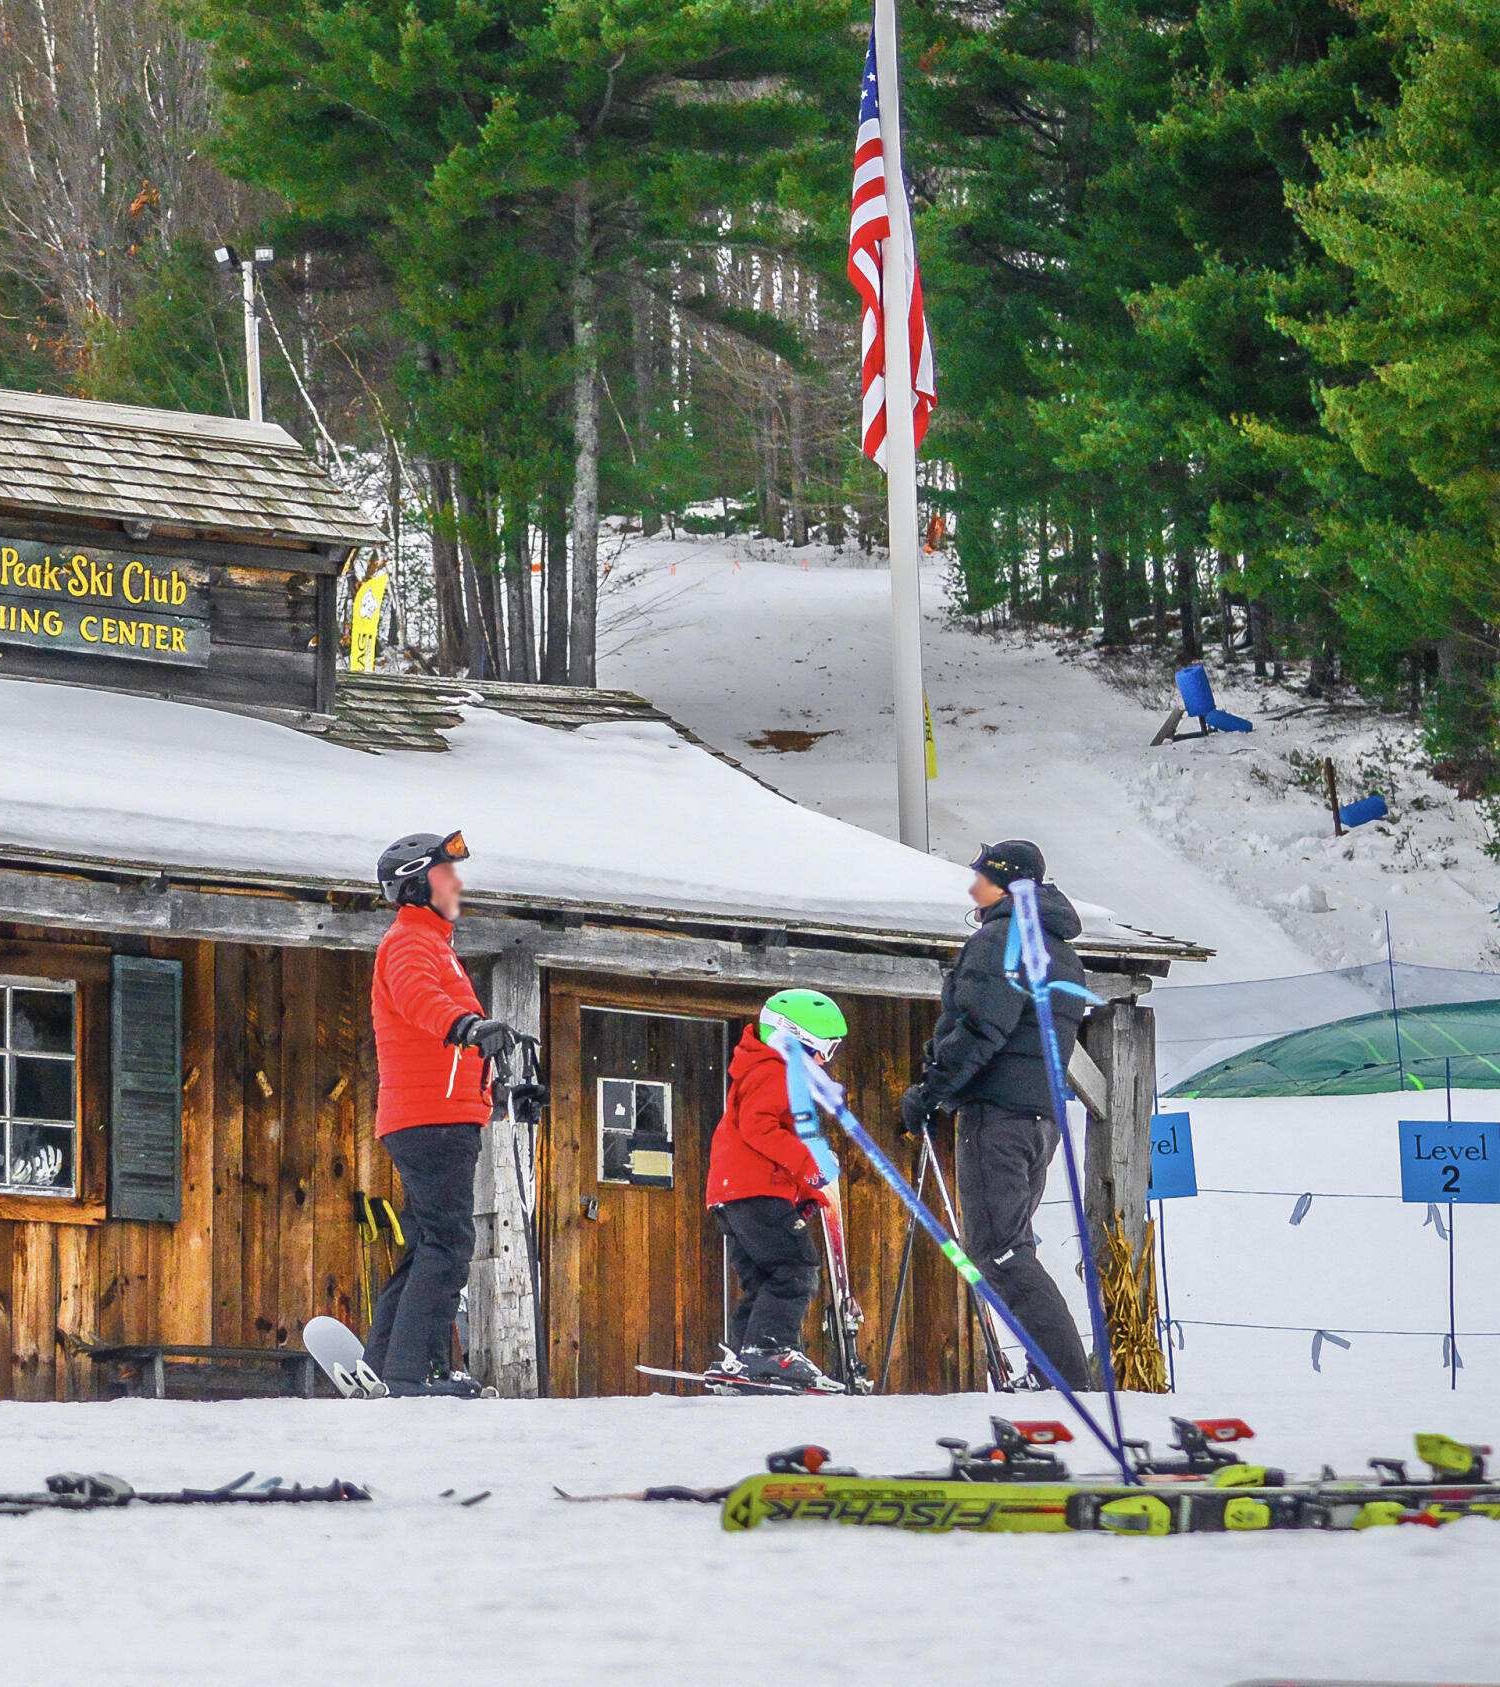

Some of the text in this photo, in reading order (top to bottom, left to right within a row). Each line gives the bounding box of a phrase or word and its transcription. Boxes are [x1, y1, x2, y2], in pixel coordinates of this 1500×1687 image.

[0, 547, 62, 591] Peak
[67, 554, 114, 598] Ski
[122, 561, 187, 605] Club
[79, 615, 188, 653] CENTER
[1413, 1133, 1489, 1161] Level
[1441, 1165, 1461, 1193] 2
[764, 1499, 998, 1528] FISCHER
